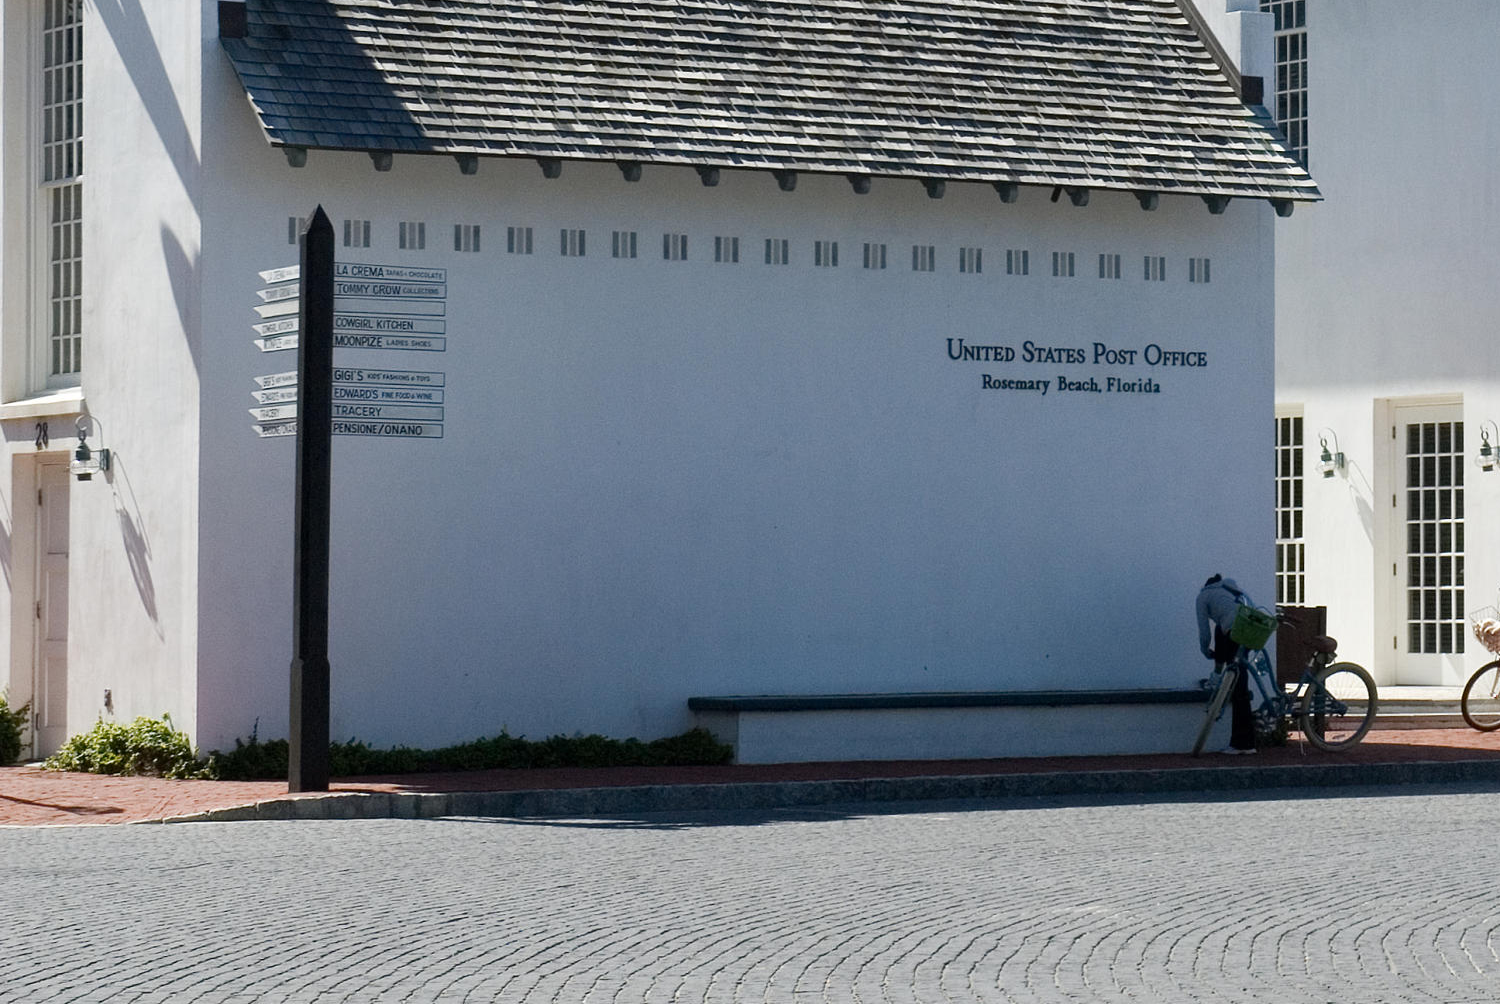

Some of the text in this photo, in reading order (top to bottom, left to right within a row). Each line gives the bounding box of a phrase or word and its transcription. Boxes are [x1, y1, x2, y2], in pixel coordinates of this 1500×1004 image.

[336, 264, 349, 275] LA
[351, 265, 384, 277] CREMA
[337, 283, 370, 294] TOMMY
[373, 284, 401, 295] CROW
[335, 317, 414, 330] COWGIRL KITCHEN
[946, 338, 1208, 367] UNITED STATES POST OFFICE
[334, 370, 364, 381] GIGI'S
[982, 374, 1160, 395] Rosemary Beach, Florida
[334, 388, 379, 399] EDWARD'S
[381, 391, 394, 399] FINE
[416, 392, 433, 401] WINE
[335, 405, 382, 417] TRACERY
[35, 421, 48, 450] 28
[333, 422, 423, 436] PENSIONE/ONANO
